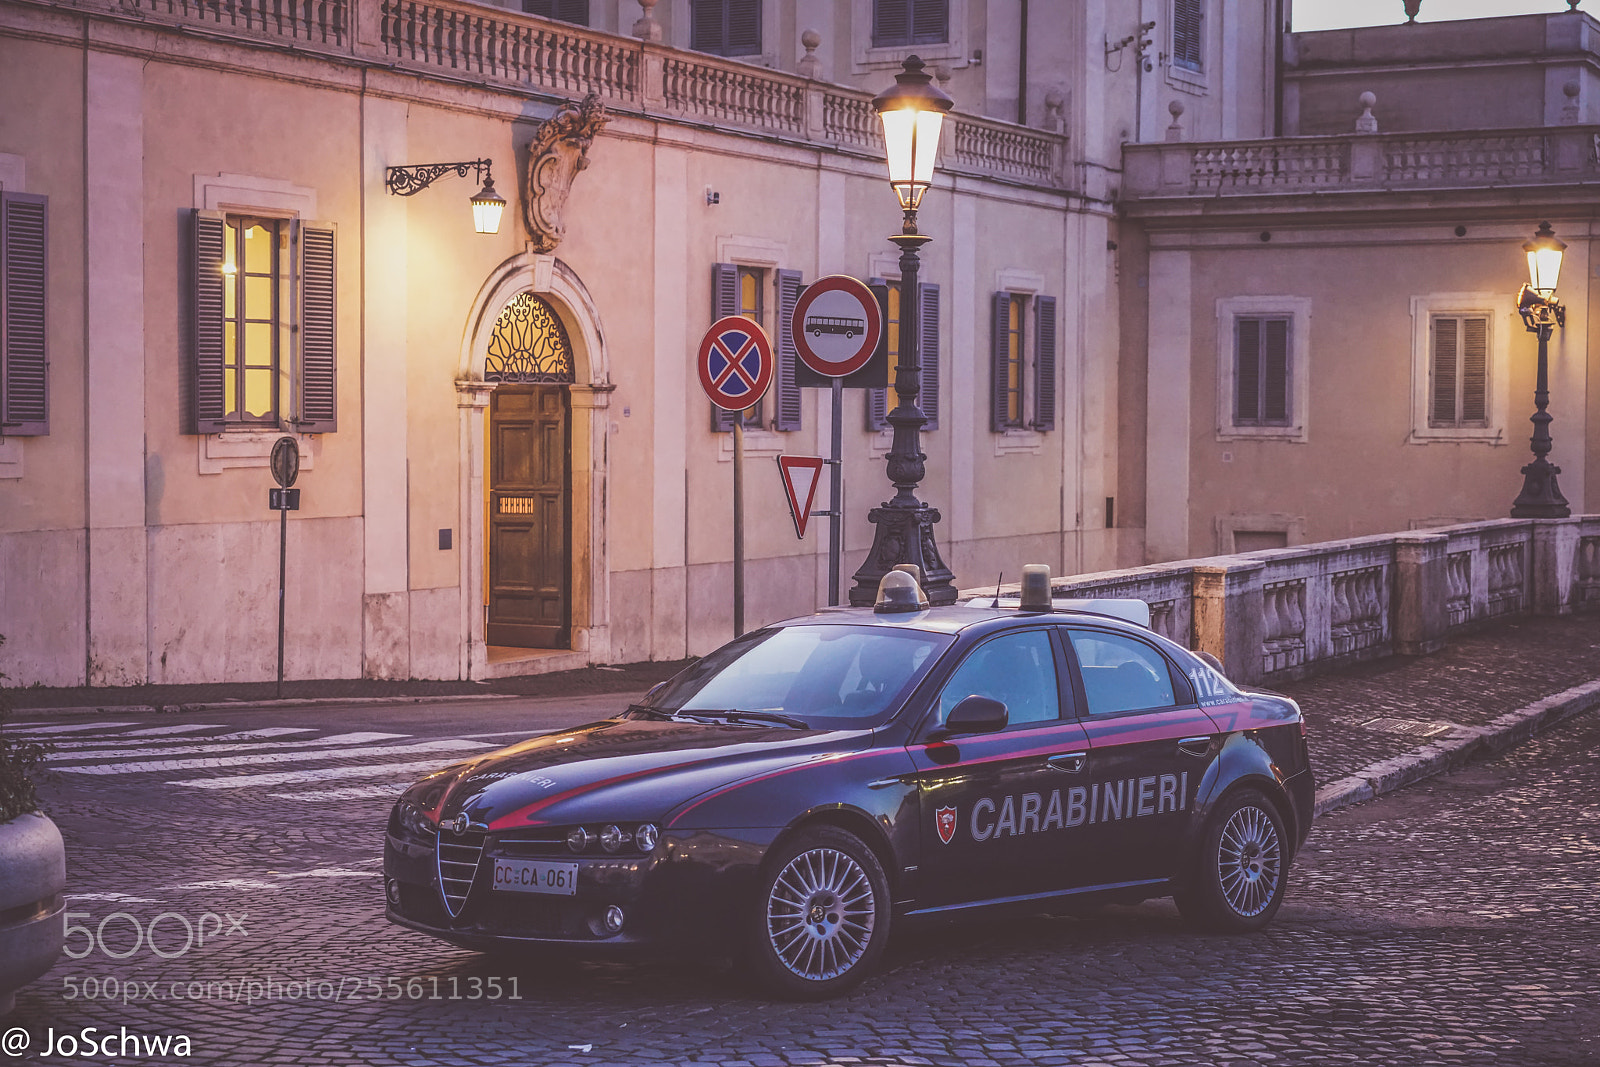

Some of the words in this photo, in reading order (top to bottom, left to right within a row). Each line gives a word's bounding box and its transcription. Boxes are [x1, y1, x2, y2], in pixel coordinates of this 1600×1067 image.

[1188, 667, 1225, 698] 112
[970, 771, 1188, 842] CARABINIERI
[495, 865, 513, 884] CC
[521, 867, 538, 886] CA
[546, 869, 573, 889] 061
